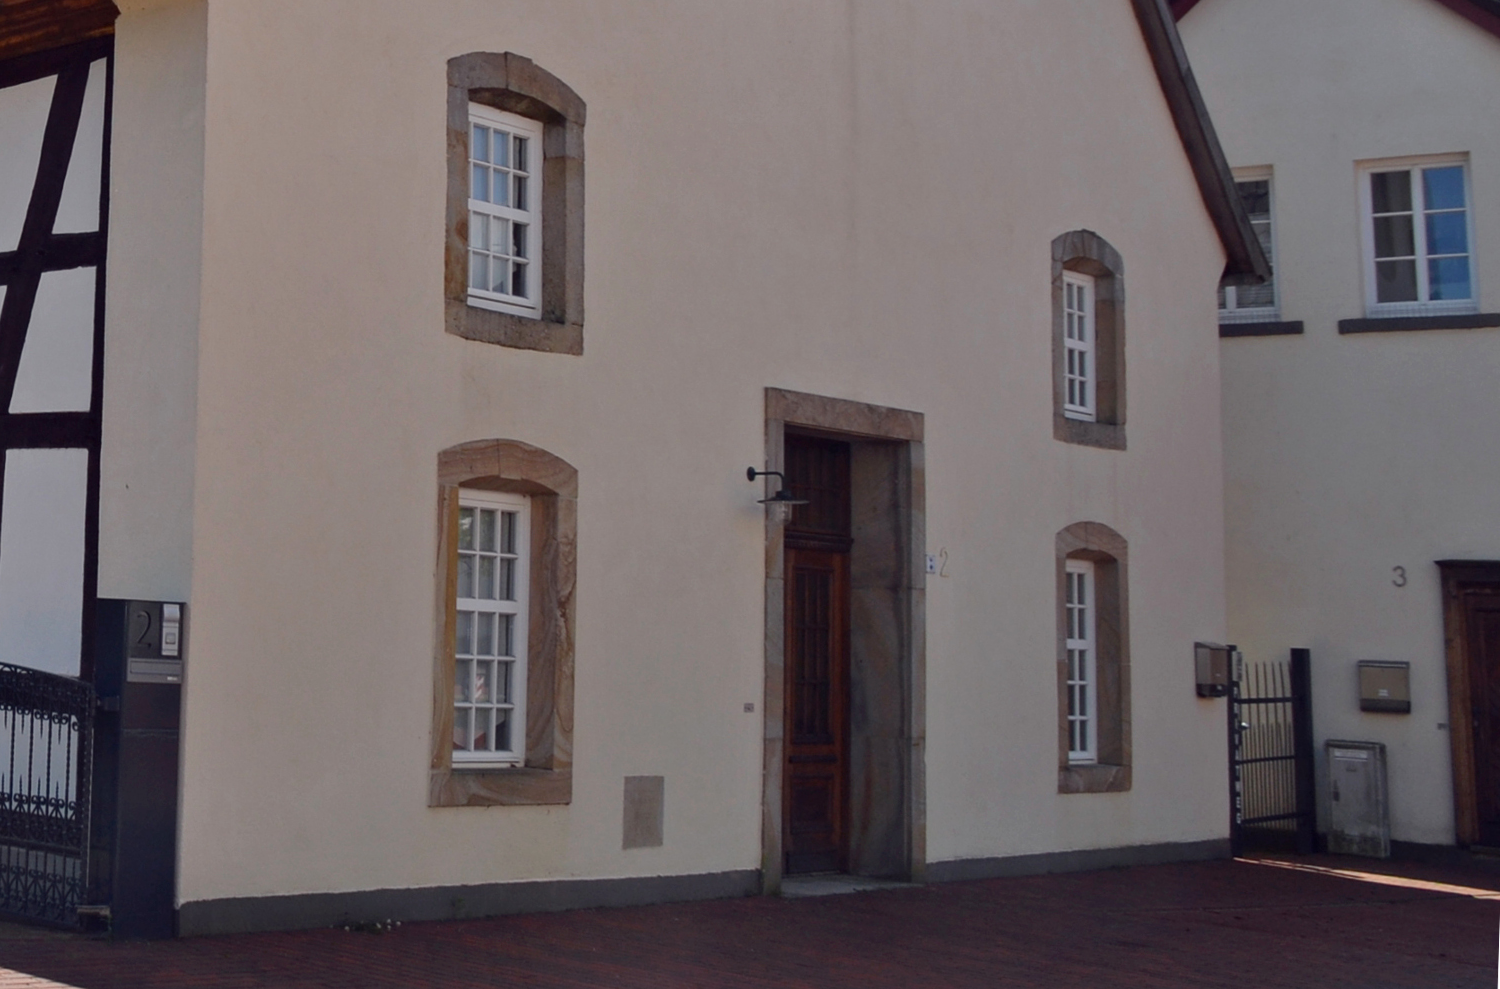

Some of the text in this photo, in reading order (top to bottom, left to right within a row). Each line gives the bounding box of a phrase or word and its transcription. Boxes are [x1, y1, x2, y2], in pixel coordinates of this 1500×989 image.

[939, 546, 950, 578] 2
[1392, 565, 1407, 588] 3
[136, 610, 152, 650] 2
